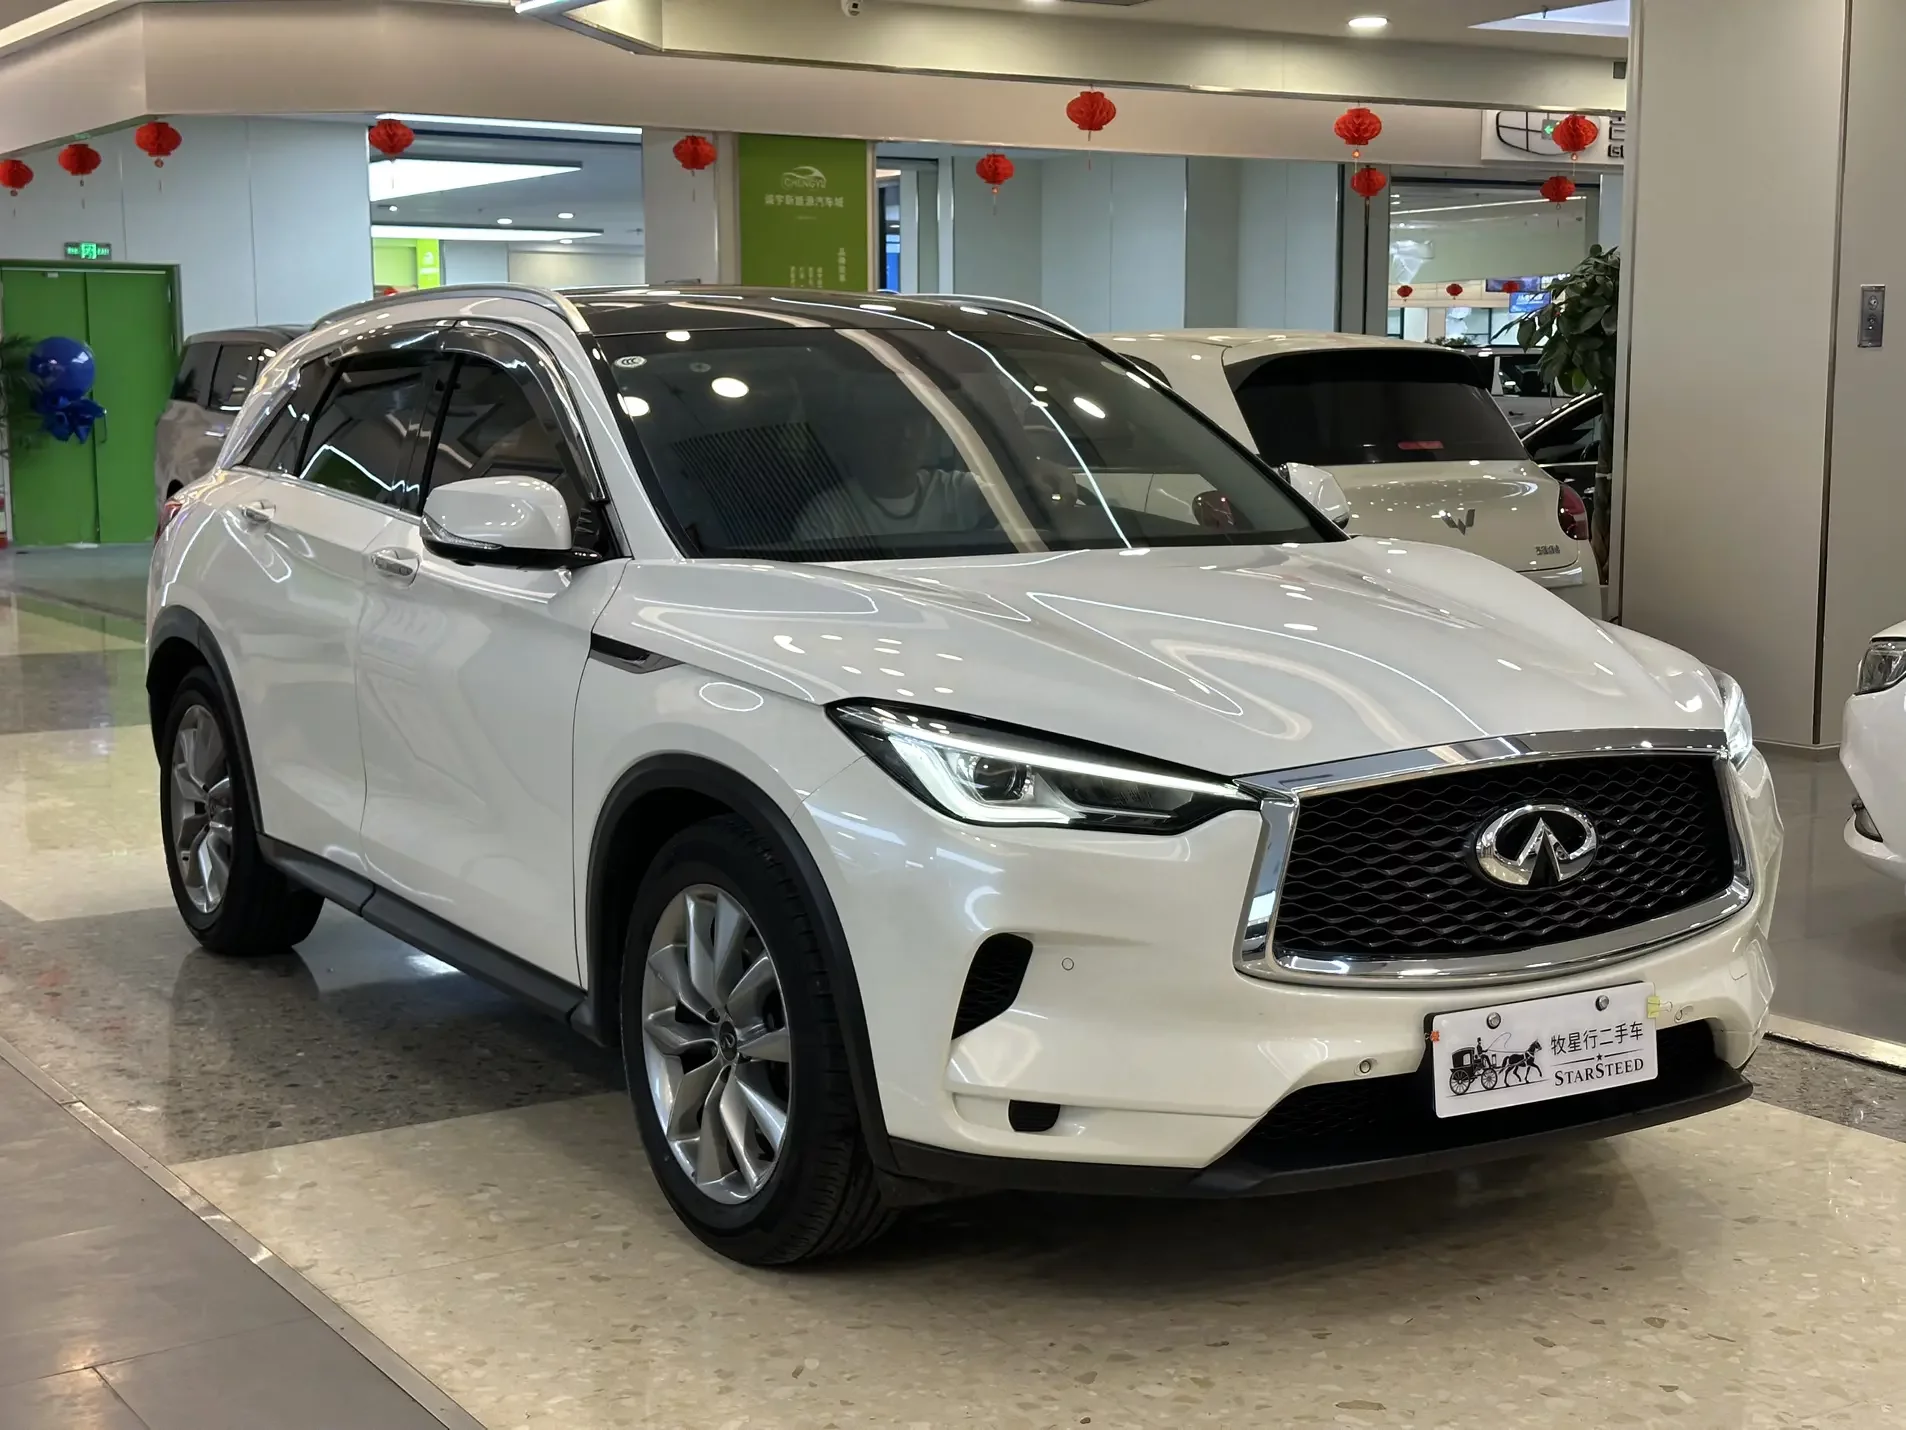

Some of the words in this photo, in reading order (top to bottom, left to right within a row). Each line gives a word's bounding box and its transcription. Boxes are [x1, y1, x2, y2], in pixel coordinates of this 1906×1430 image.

[1550, 1021, 1643, 1055] 牧星行二手车
